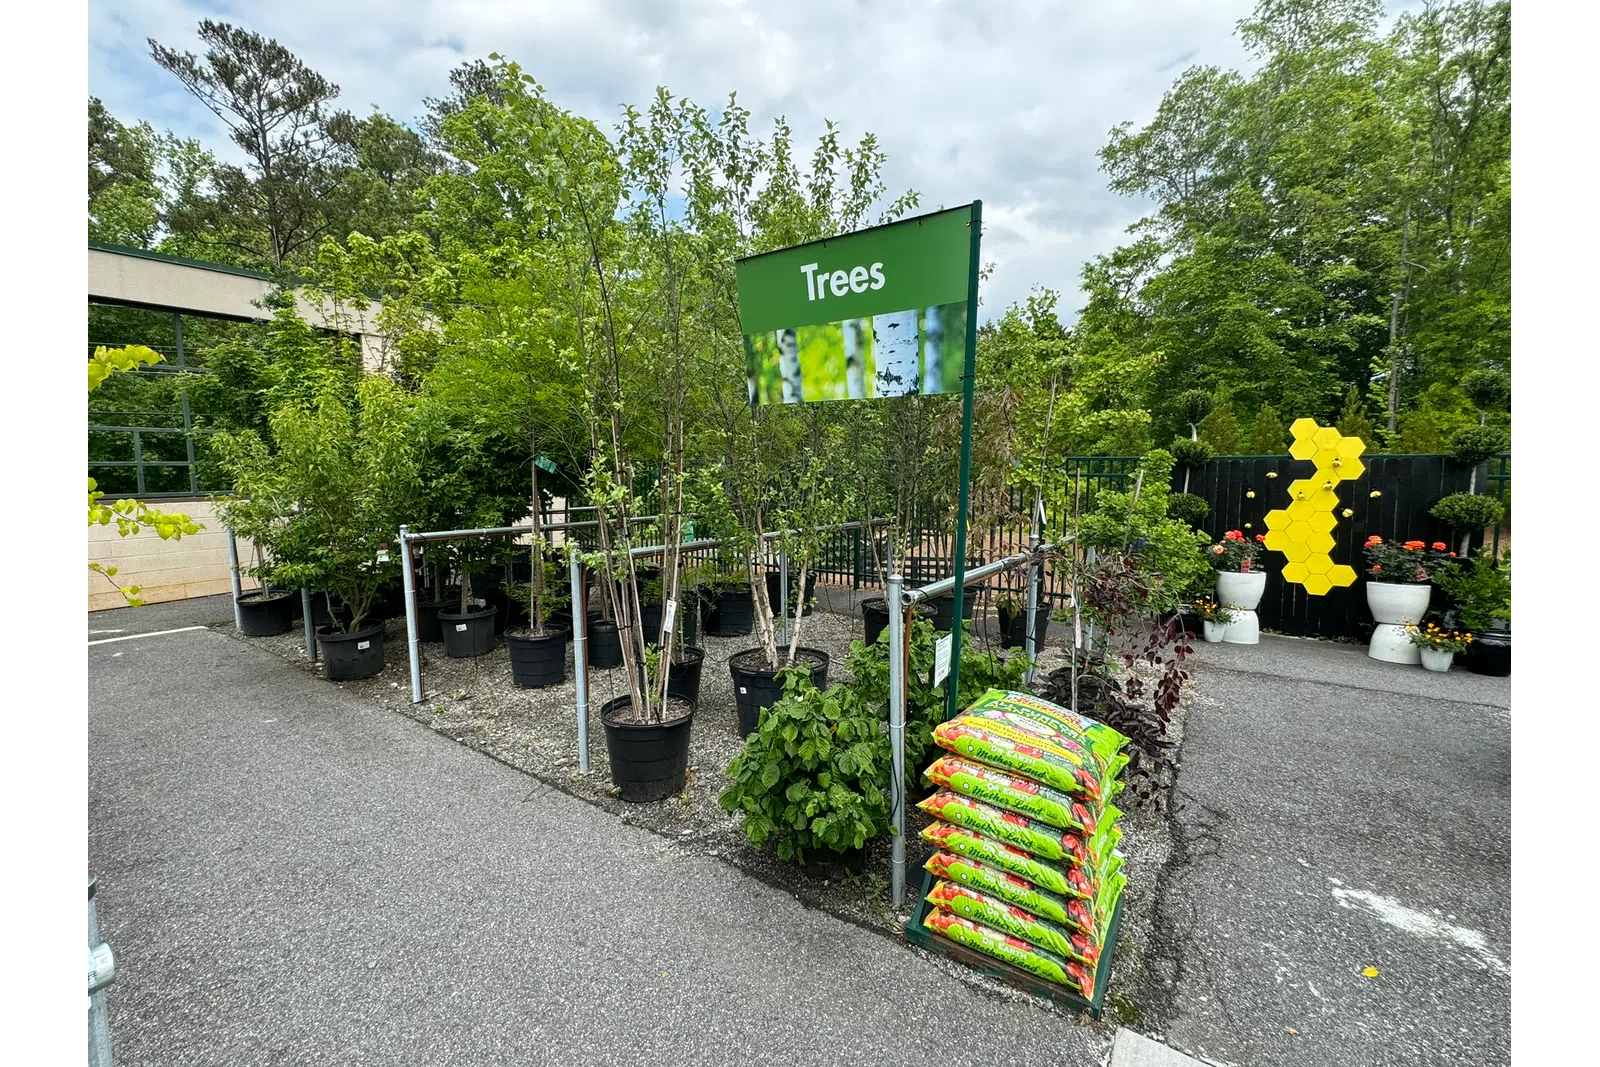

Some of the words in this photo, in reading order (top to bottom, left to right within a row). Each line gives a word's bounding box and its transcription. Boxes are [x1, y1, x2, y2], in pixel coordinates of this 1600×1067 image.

[800, 262, 885, 301] Trees
[976, 748, 1013, 767] Mother
[1015, 762, 1046, 778] Land
[1006, 750, 1036, 766] EARTH
[972, 786, 1010, 804] Mother
[1011, 799, 1043, 816] Land
[1003, 788, 1032, 802] EARTH
[969, 846, 1004, 866] Mother
[1006, 862, 1038, 880] Land
[970, 876, 1005, 897] Mother
[1000, 881, 1028, 897] EARTH
[974, 910, 1010, 930] Mother
[1012, 926, 1042, 944] Land
[1003, 913, 1032, 930] EARTH
[969, 939, 1005, 960] Mother
[1009, 955, 1039, 972] Land
[998, 943, 1027, 960] EARTH
